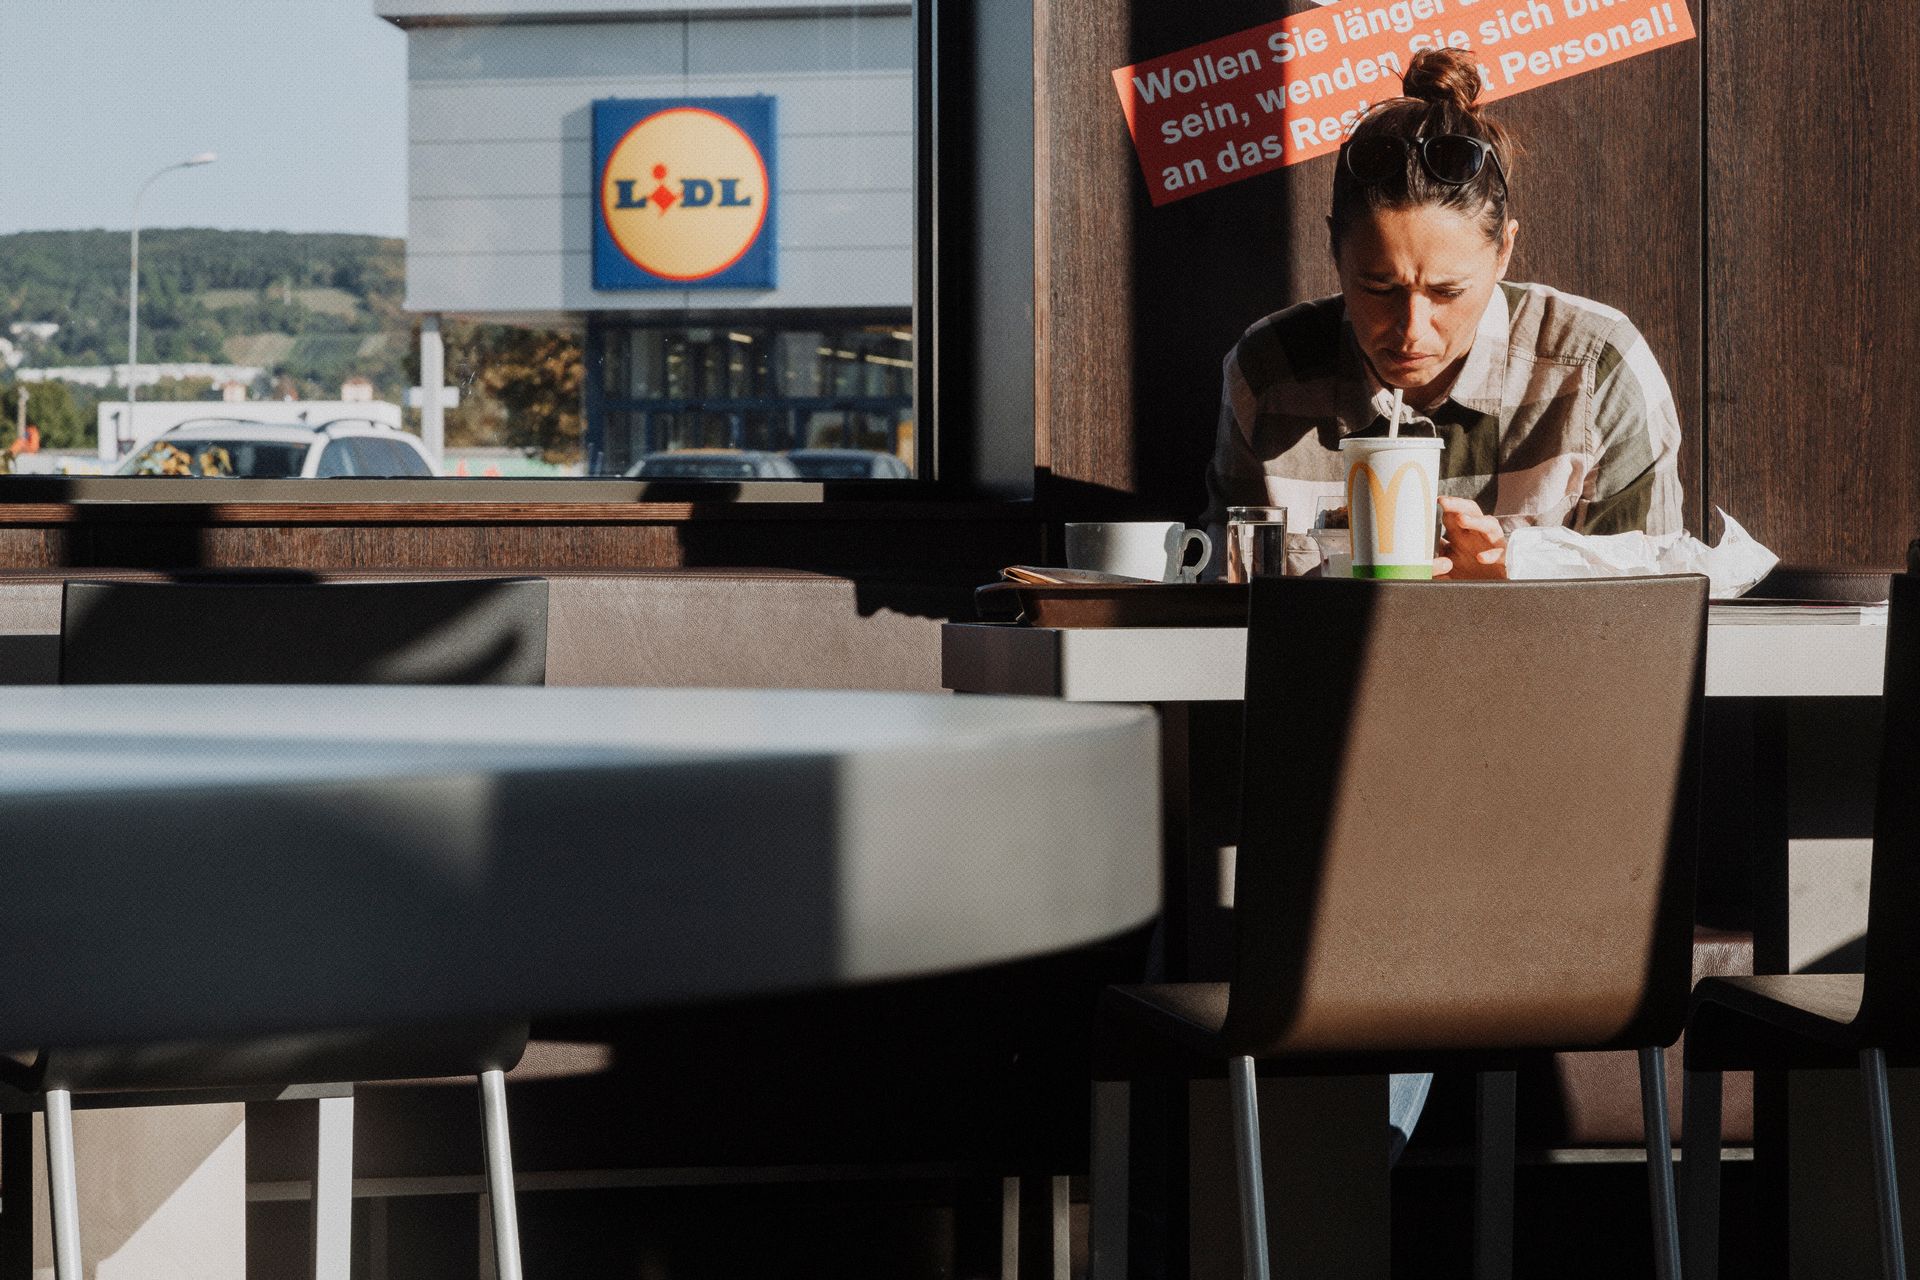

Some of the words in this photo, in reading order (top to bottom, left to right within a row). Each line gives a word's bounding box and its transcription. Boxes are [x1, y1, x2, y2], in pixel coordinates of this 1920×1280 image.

[1133, 49, 1261, 104] Wollen
[1267, 27, 1328, 63] Sie
[1160, 102, 1250, 144] sein,
[1256, 51, 1402, 114] wenden
[1478, 0, 1554, 45] sich
[1161, 158, 1207, 191] an
[1216, 135, 1283, 173] das
[1499, 3, 1678, 85] Personal!
